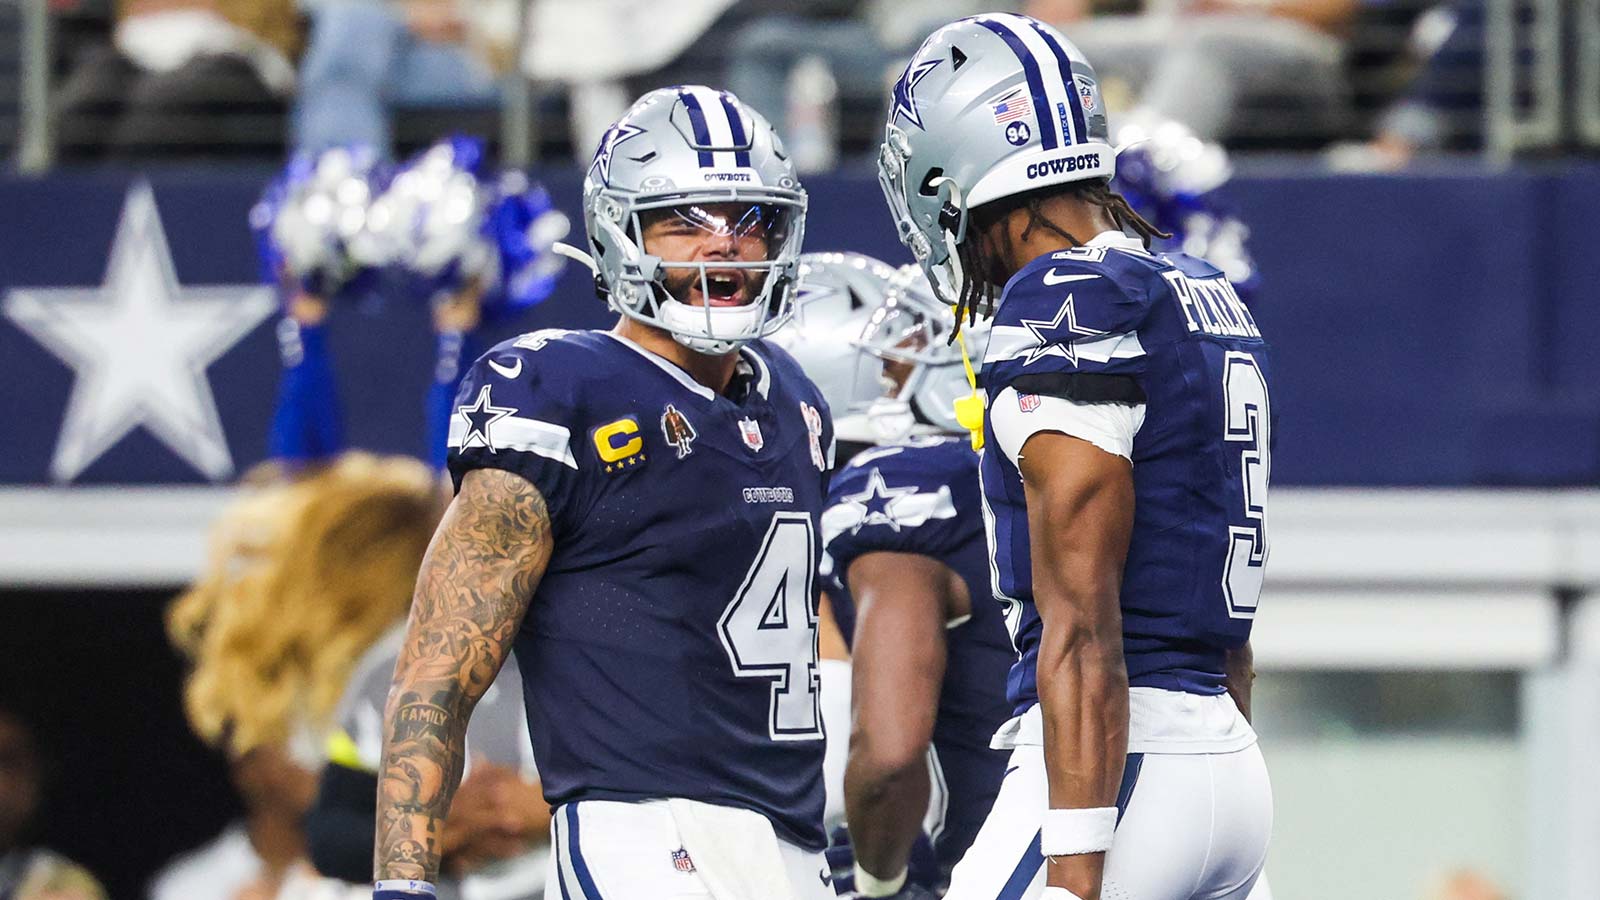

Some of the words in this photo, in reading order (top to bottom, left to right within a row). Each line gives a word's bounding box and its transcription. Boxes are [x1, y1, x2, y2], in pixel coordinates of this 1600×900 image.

[1006, 123, 1029, 143] 94
[1026, 153, 1100, 180] COWBOYS
[1020, 394, 1040, 410] NFL
[593, 418, 643, 463] C
[742, 487, 795, 503] COWBOYS
[1221, 350, 1271, 619] 3
[716, 511, 825, 742] 4
[401, 707, 448, 727] FAMILY
